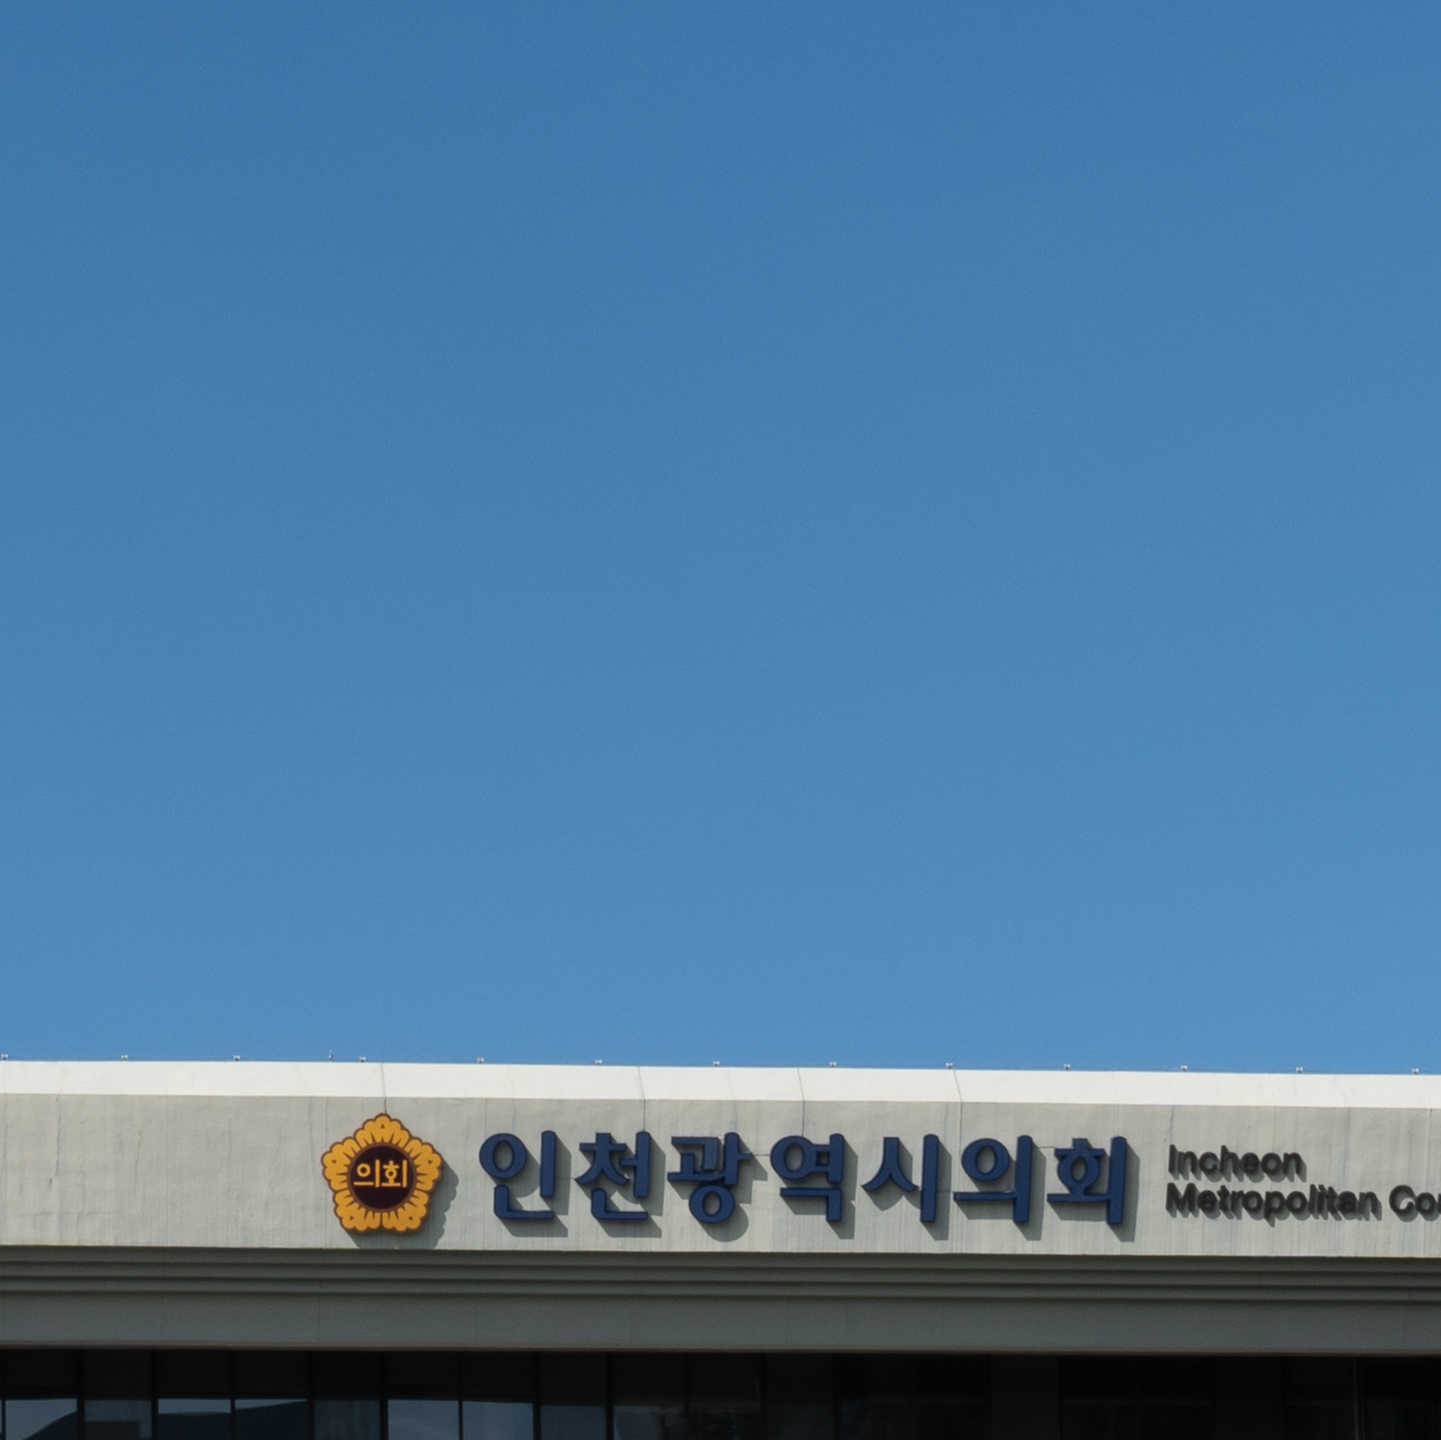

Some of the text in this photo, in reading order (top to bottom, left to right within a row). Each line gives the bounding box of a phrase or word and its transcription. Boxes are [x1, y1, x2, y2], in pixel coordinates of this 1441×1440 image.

[353, 1159, 408, 1188] 의회
[478, 1130, 1128, 1226] 인천광역시의회
[1168, 1144, 1306, 1182] Incheon
[1166, 1182, 1382, 1227] Metropolitan
